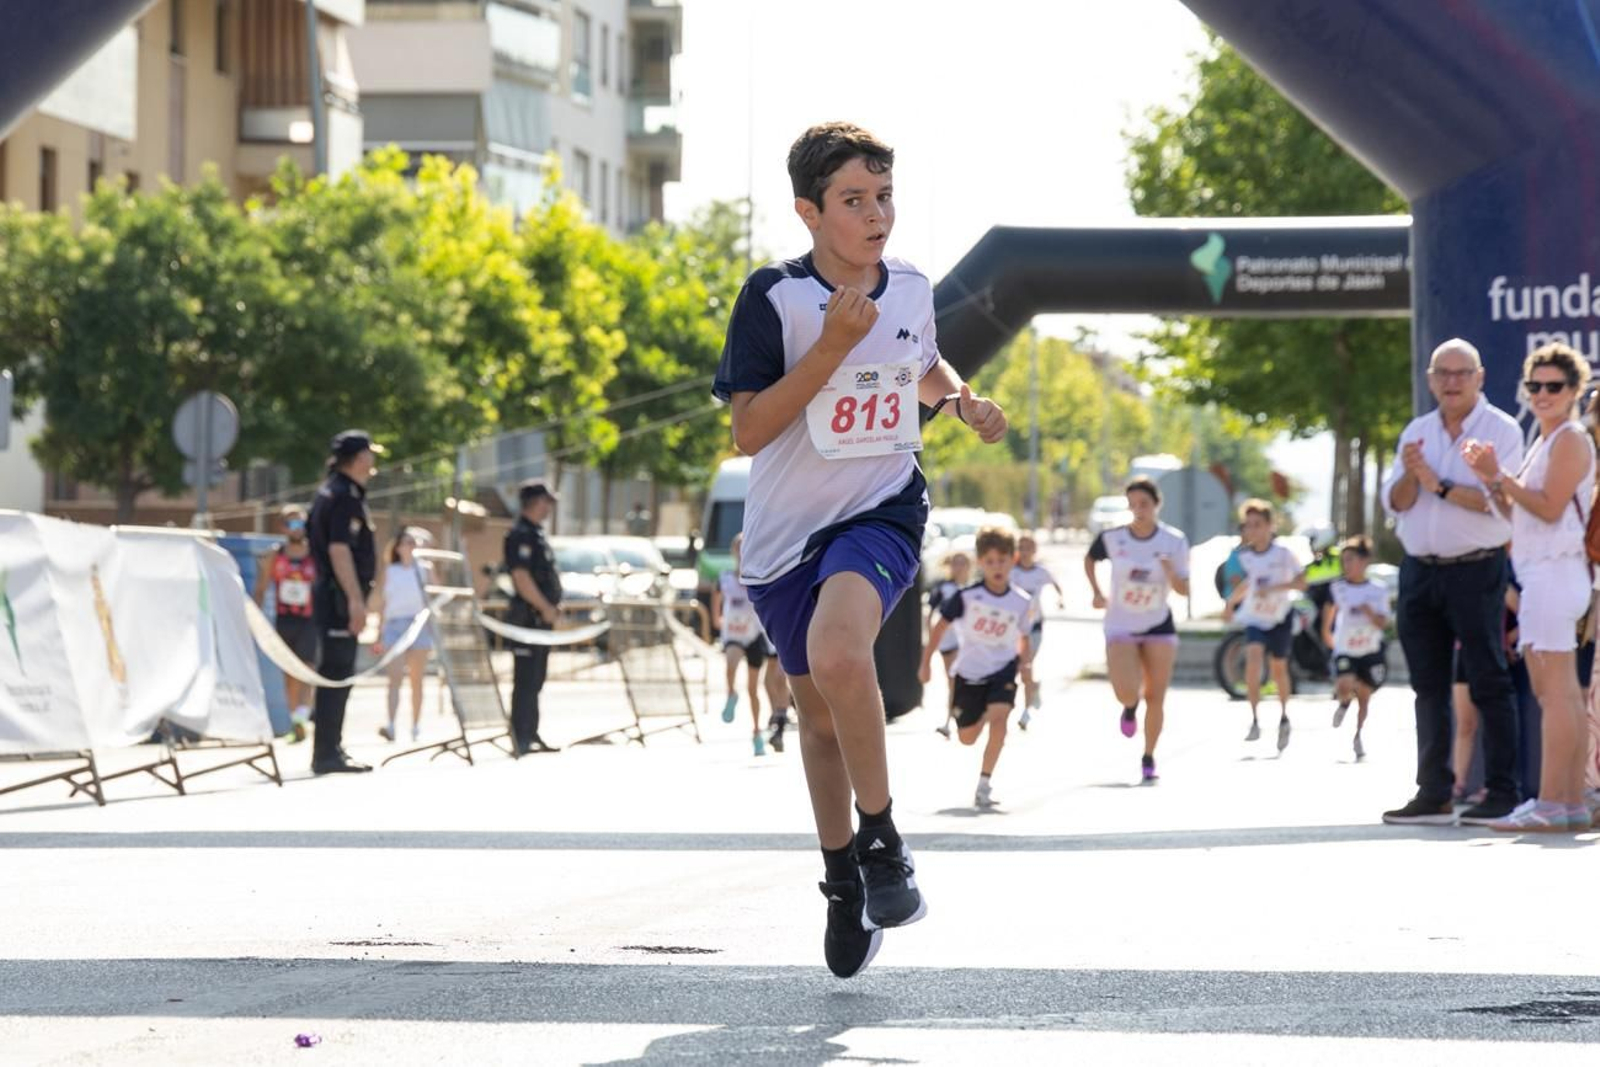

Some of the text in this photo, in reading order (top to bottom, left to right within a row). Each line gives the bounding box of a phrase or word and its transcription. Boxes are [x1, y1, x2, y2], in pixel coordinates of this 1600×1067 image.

[1236, 255, 1318, 273] Patronato
[1320, 254, 1403, 273] Municipal
[1236, 275, 1314, 293] Deportes
[1316, 275, 1341, 291] de
[831, 392, 900, 433] 813
[973, 617, 1007, 637] 830
